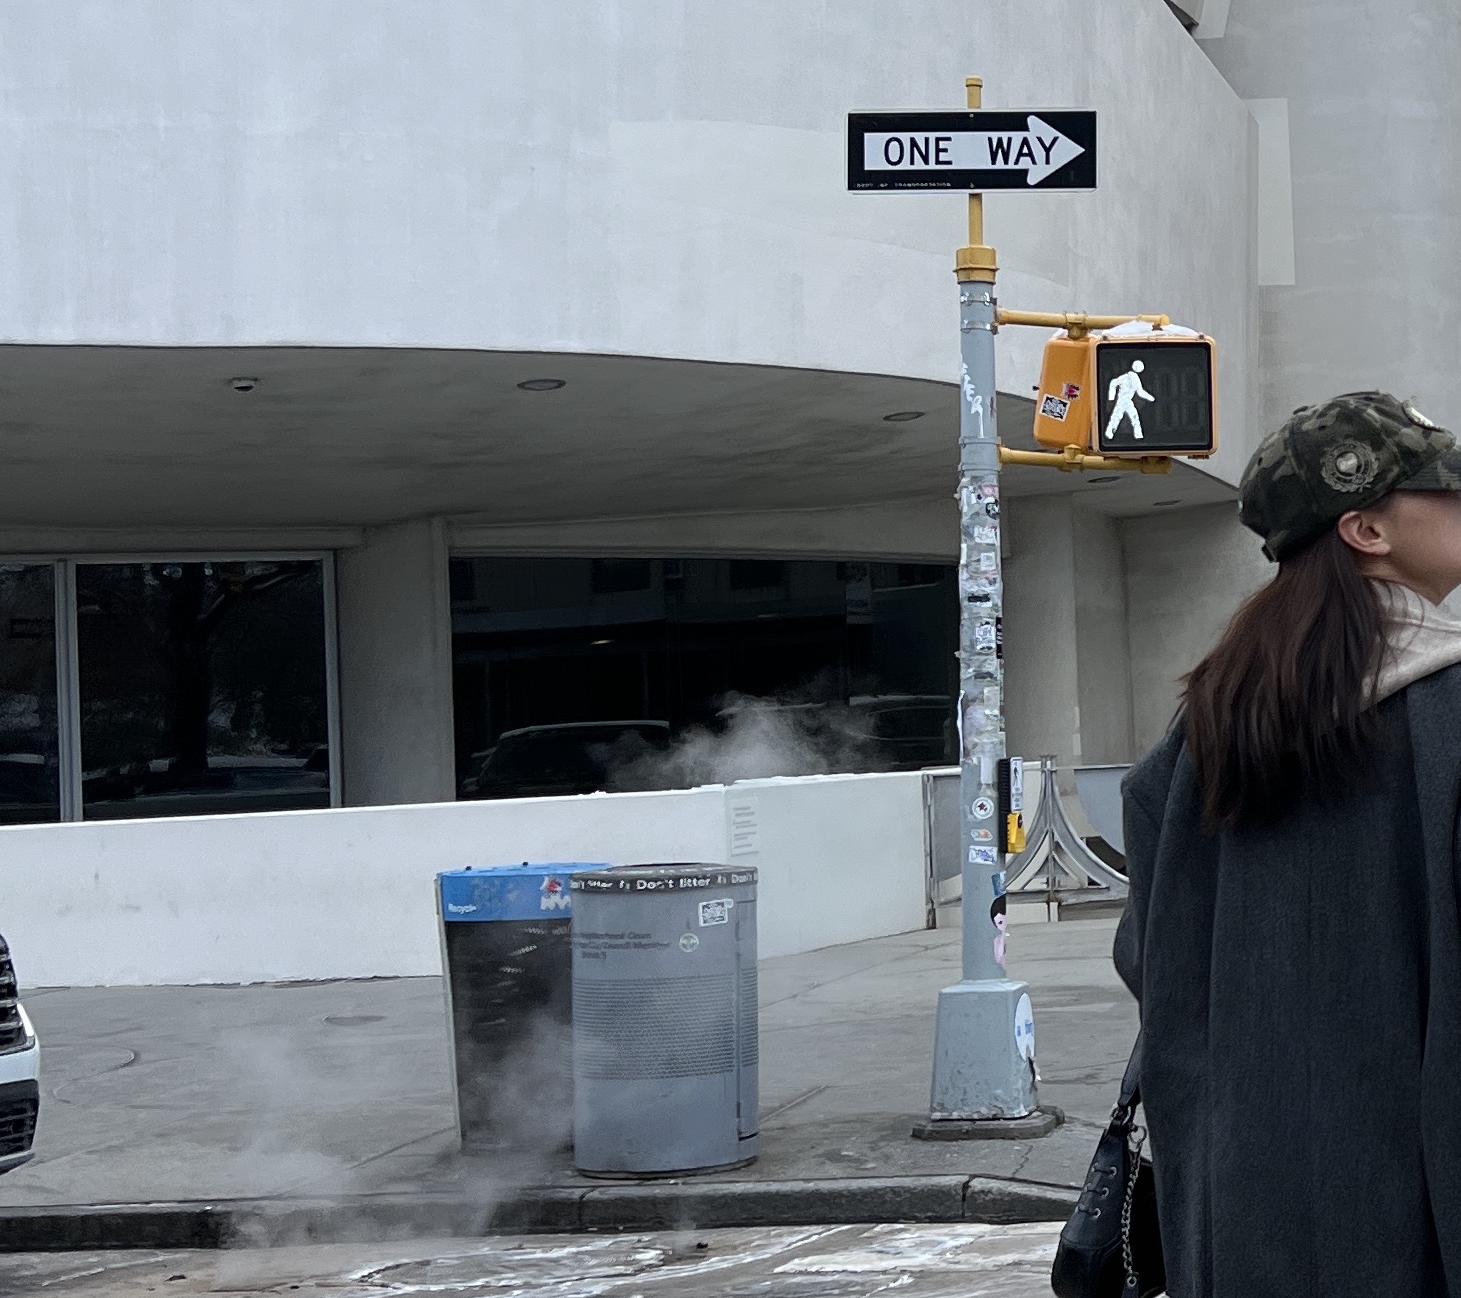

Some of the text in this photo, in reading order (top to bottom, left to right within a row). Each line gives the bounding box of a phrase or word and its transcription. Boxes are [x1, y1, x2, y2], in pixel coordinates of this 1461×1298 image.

[883, 136, 1060, 166] ONE WAY
[636, 878, 675, 891] Don't
